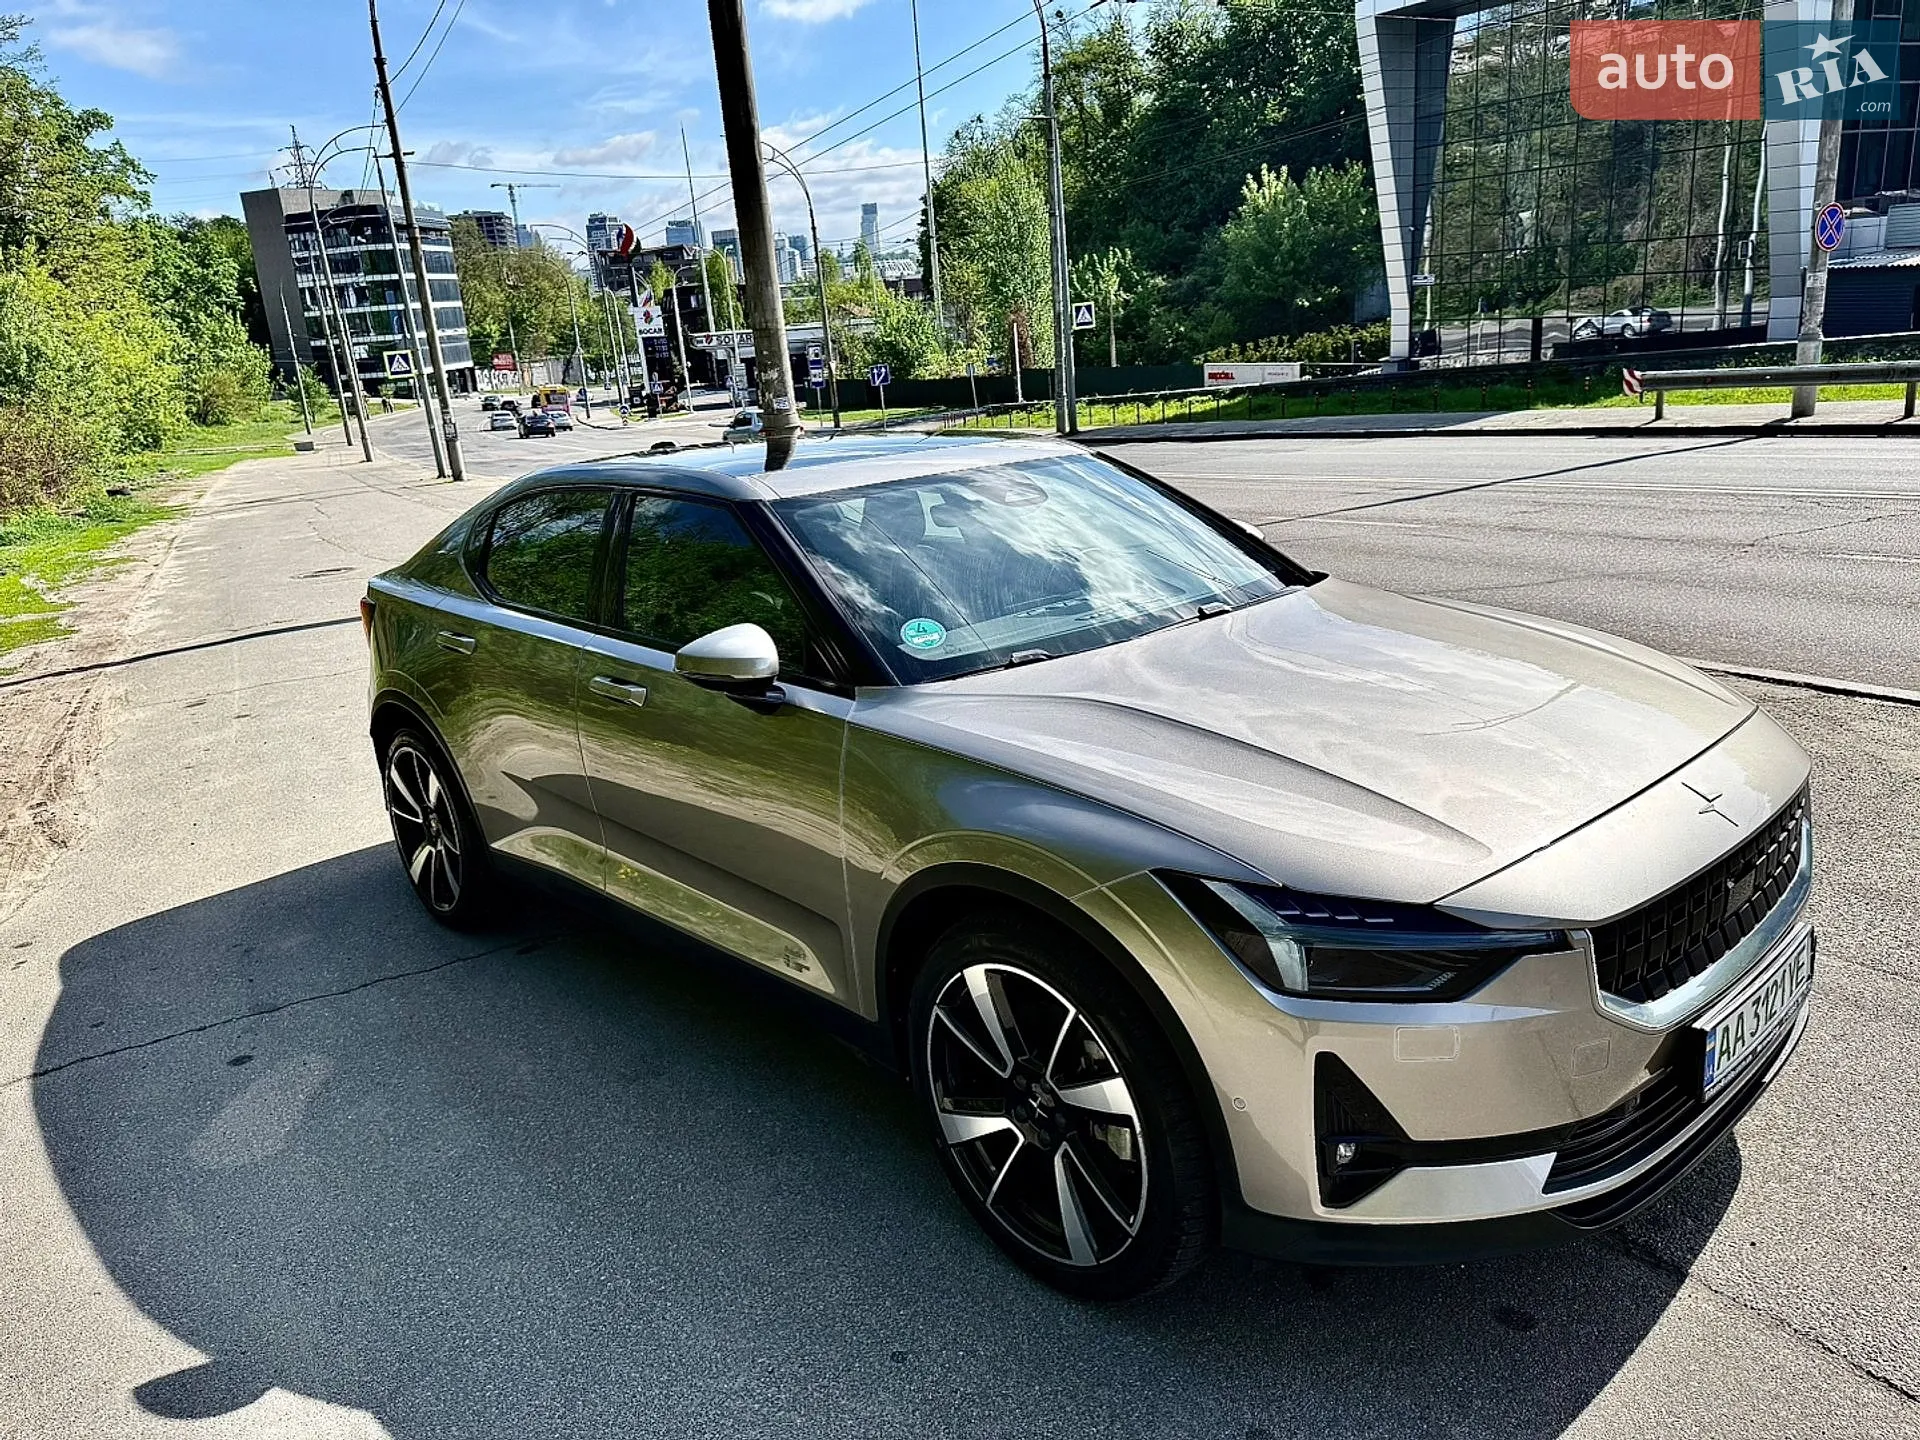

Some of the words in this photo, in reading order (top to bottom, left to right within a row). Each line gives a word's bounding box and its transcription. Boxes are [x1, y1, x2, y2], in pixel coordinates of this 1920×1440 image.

[1716, 1011, 1746, 1071] AA
[1750, 969, 1787, 1038] 3121
[1788, 944, 1806, 998] YE
